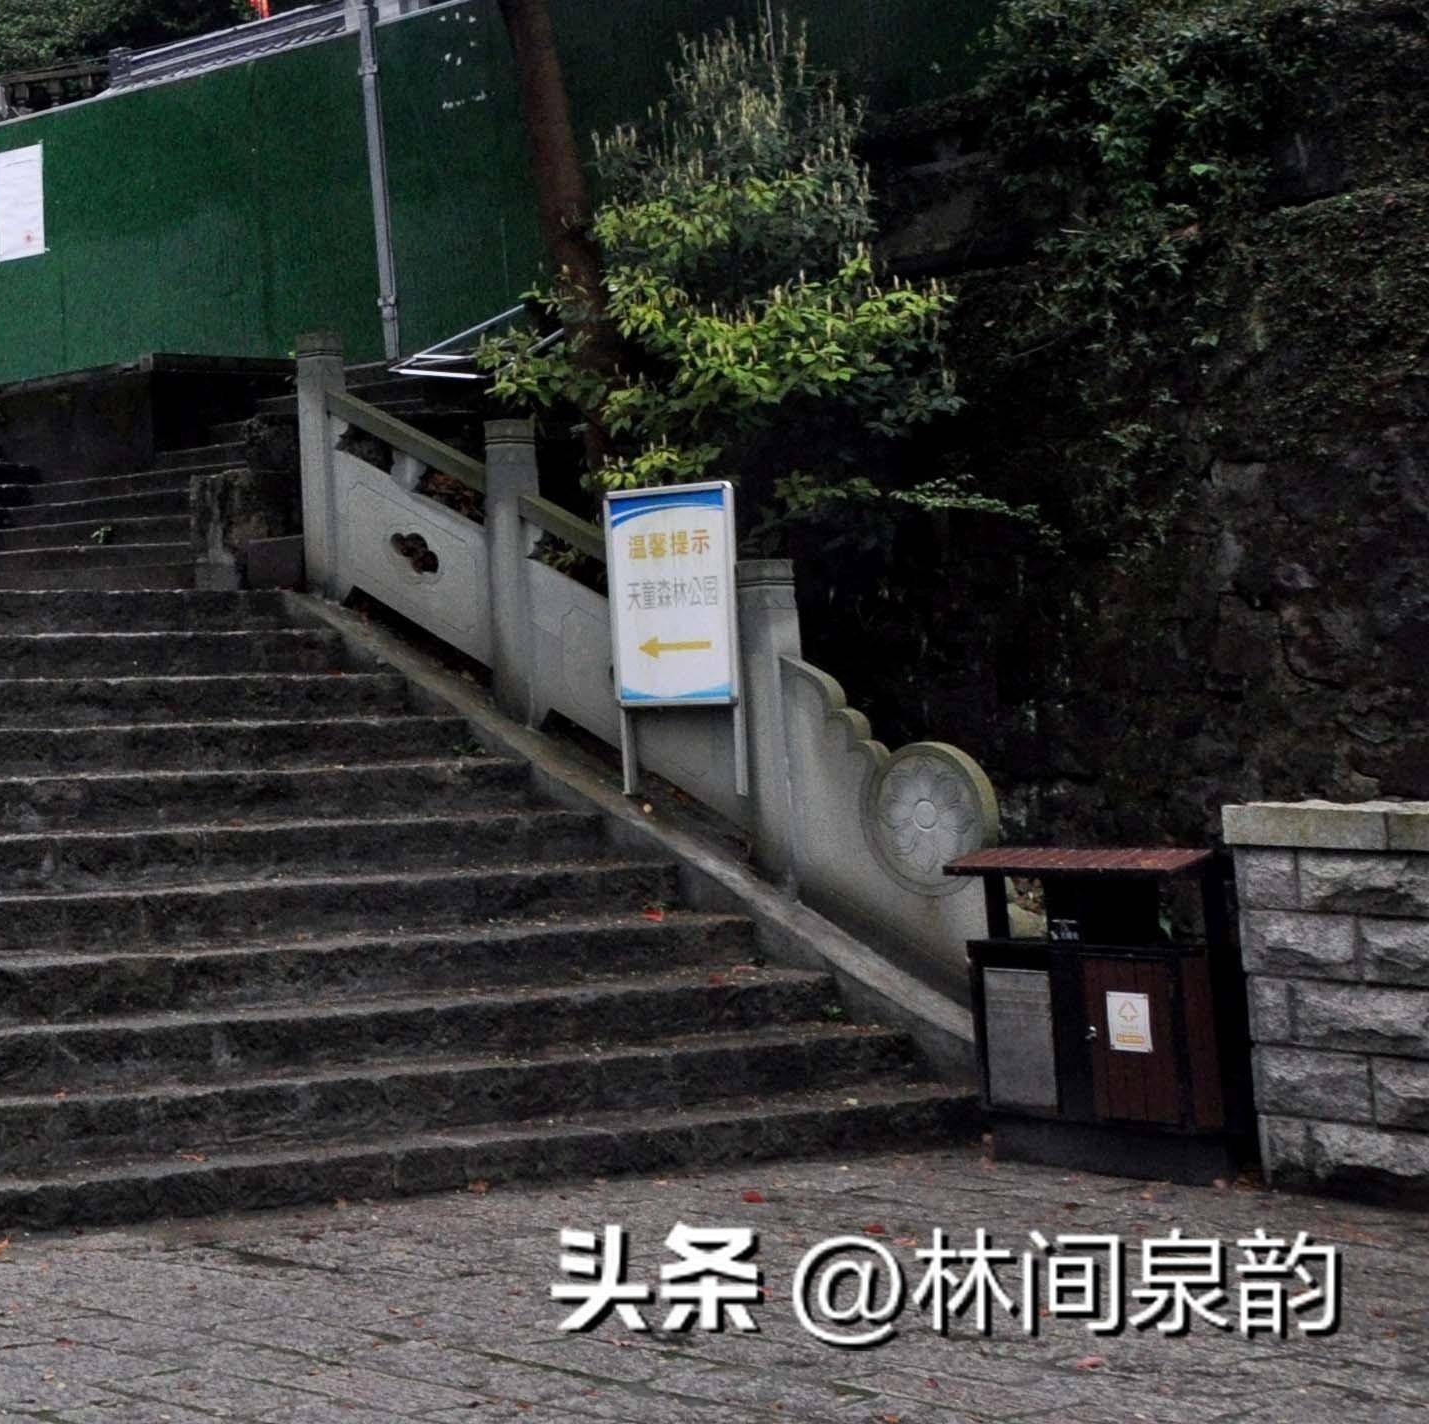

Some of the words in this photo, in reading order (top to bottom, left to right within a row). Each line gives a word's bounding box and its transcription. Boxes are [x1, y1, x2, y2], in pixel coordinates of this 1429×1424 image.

[627, 528, 710, 560] 温馨提示
[626, 575, 718, 611] 天童森林公园
